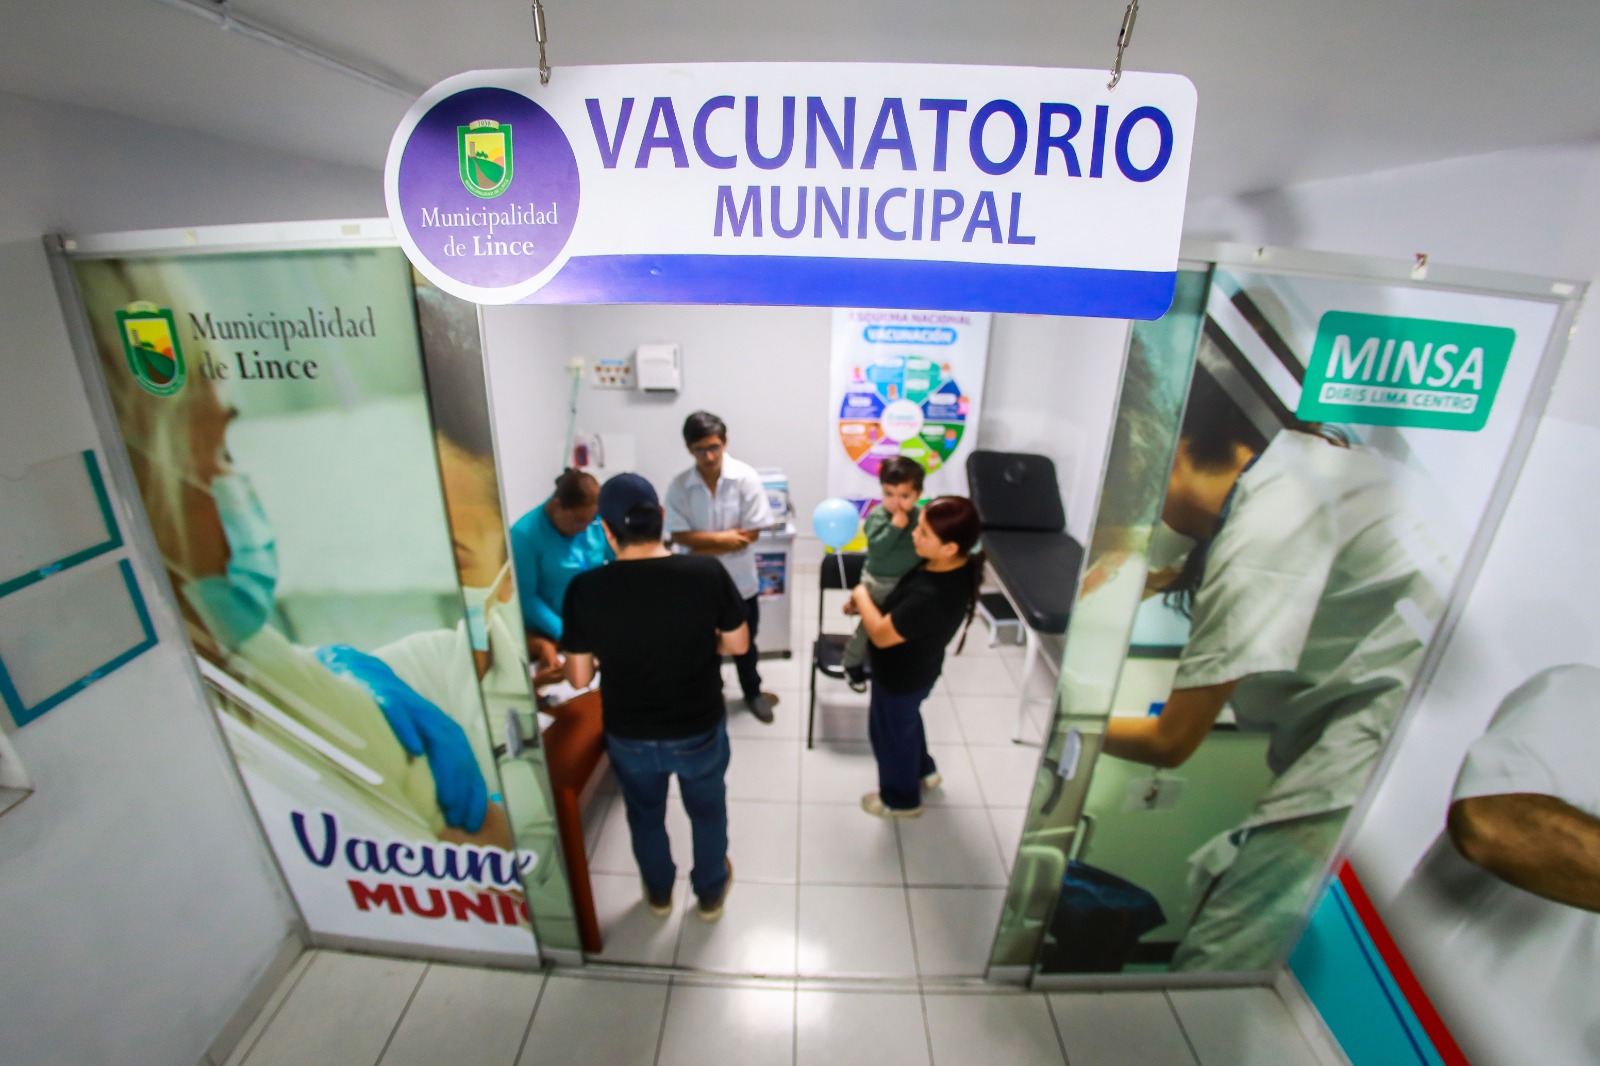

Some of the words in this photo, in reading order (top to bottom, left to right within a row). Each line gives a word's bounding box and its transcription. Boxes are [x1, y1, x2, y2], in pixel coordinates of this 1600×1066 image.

[585, 95, 1173, 182] VACUNATORIO
[421, 202, 559, 235] Municipalidad
[714, 185, 1036, 245] MUNICIPAL
[444, 235, 466, 257] de
[473, 234, 535, 256] Lince
[188, 306, 377, 351] Municipalidad
[200, 352, 228, 380] de
[235, 350, 319, 380] Lince
[1325, 334, 1485, 391] MINSA
[1325, 386, 1367, 401] DIRIS
[1371, 390, 1408, 404] LIMA
[1412, 393, 1473, 410] CENTRO
